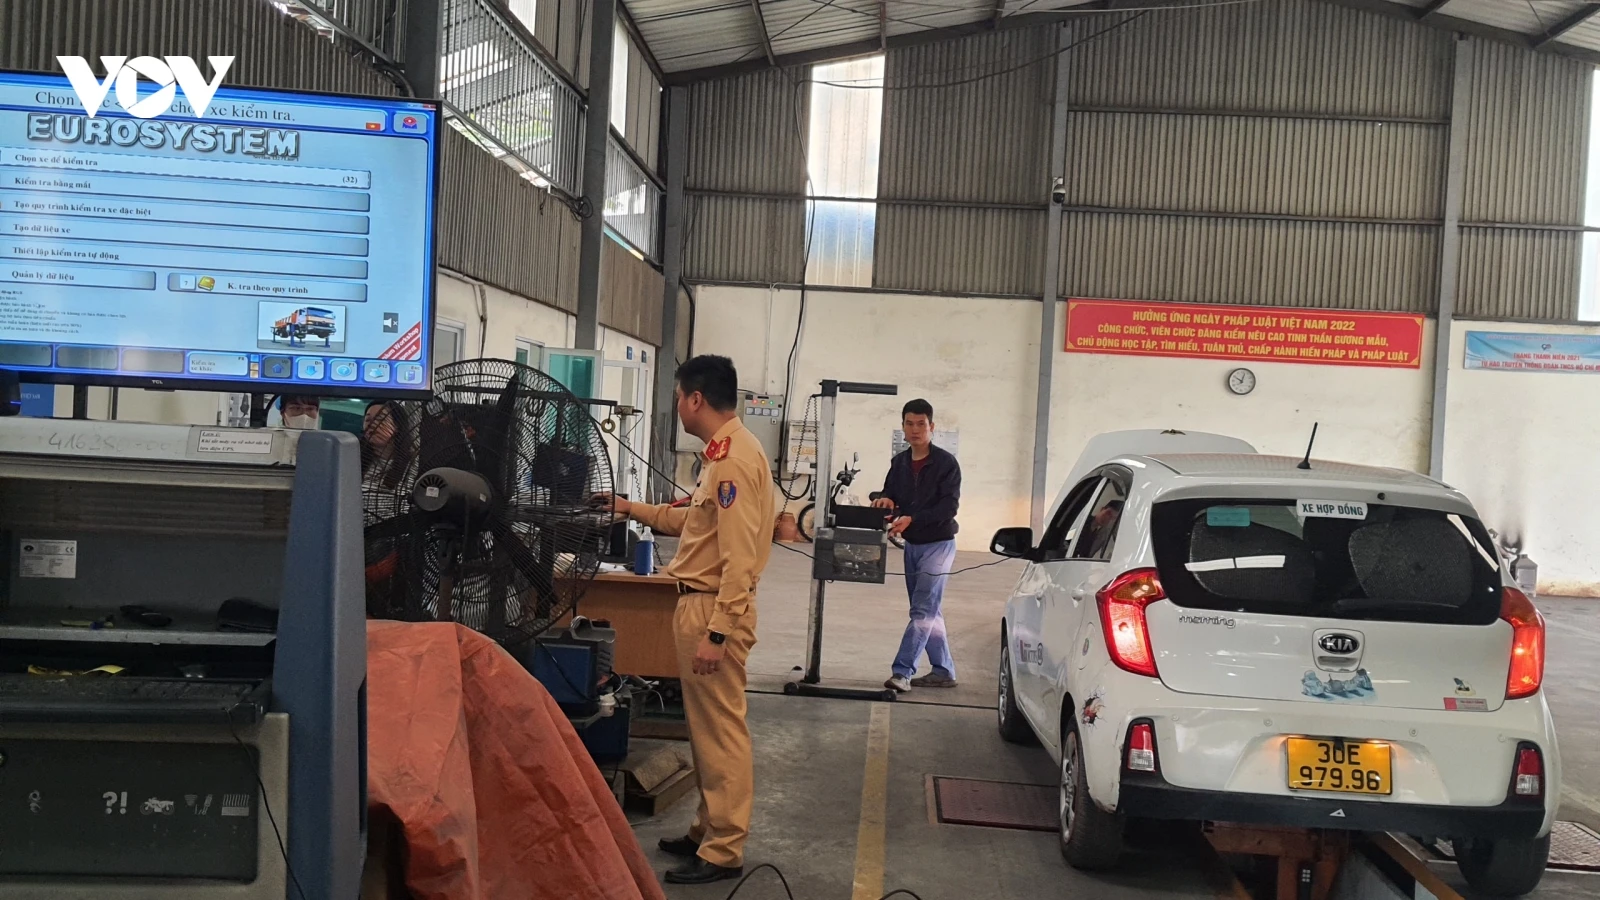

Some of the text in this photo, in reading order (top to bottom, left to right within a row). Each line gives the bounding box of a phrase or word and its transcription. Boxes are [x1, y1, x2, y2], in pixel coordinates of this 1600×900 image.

[35, 91, 74, 108] Chọn
[210, 106, 227, 116] xe
[232, 104, 268, 119] kiểm
[273, 110, 295, 121] tra.
[27, 112, 299, 157] EUROSYSTEM
[15, 154, 37, 163] Chọn
[62, 155, 83, 165] kiểm
[14, 177, 37, 185] Kiểm
[342, 176, 358, 184] (32)
[13, 200, 30, 209] Tạo
[48, 202, 69, 211] trình
[70, 203, 92, 212] kiểm
[135, 207, 152, 216] biệt
[13, 223, 29, 232] Tạo
[43, 224, 59, 233] liệu
[12, 246, 34, 255] Thiết
[36, 248, 49, 256] lập
[51, 247, 72, 257] kiểm
[88, 251, 97, 259] tự
[99, 252, 120, 260] động
[11, 270, 34, 279] Quản
[59, 272, 75, 281] liệu
[227, 282, 237, 290] K.
[253, 284, 271, 292] theo
[272, 286, 286, 294] quy
[288, 286, 309, 294] trình
[1133, 309, 1167, 322] HƯỞNG
[1194, 311, 1221, 325] NGÀY
[1223, 312, 1250, 326] PHÁP
[1253, 315, 1277, 329] LUẬT
[1280, 316, 1302, 330] VIỆT
[1304, 319, 1328, 329] NAM
[1330, 320, 1356, 331] 2022
[393, 327, 419, 350] Workshop
[1098, 323, 1121, 333] CÔNG
[1151, 325, 1171, 336] VIÊN
[1248, 330, 1265, 341] NÊU
[1268, 333, 1285, 342] CAO
[1287, 333, 1307, 343] TINH
[1334, 335, 1364, 346] GƯƠNG
[1077, 336, 1094, 346] CHỦ
[1096, 337, 1120, 349] ĐỘNG
[1121, 339, 1139, 349] HỌC
[1160, 339, 1176, 351] TÌM
[1203, 341, 1225, 353] TUÂN
[1248, 343, 1271, 355] CHẤP
[1273, 345, 1298, 356] HÀNH
[1322, 347, 1346, 359] PHÁP
[1348, 348, 1360, 359] VÀ
[1362, 349, 1385, 360] PHÁP
[1387, 350, 1409, 363] LUẬT
[1302, 503, 1314, 513] XE
[1316, 503, 1335, 515] HỢP
[1179, 615, 1236, 629] morning
[1326, 638, 1353, 650] KIA
[1318, 742, 1361, 766] 30E
[1299, 766, 1380, 791] 979.96
